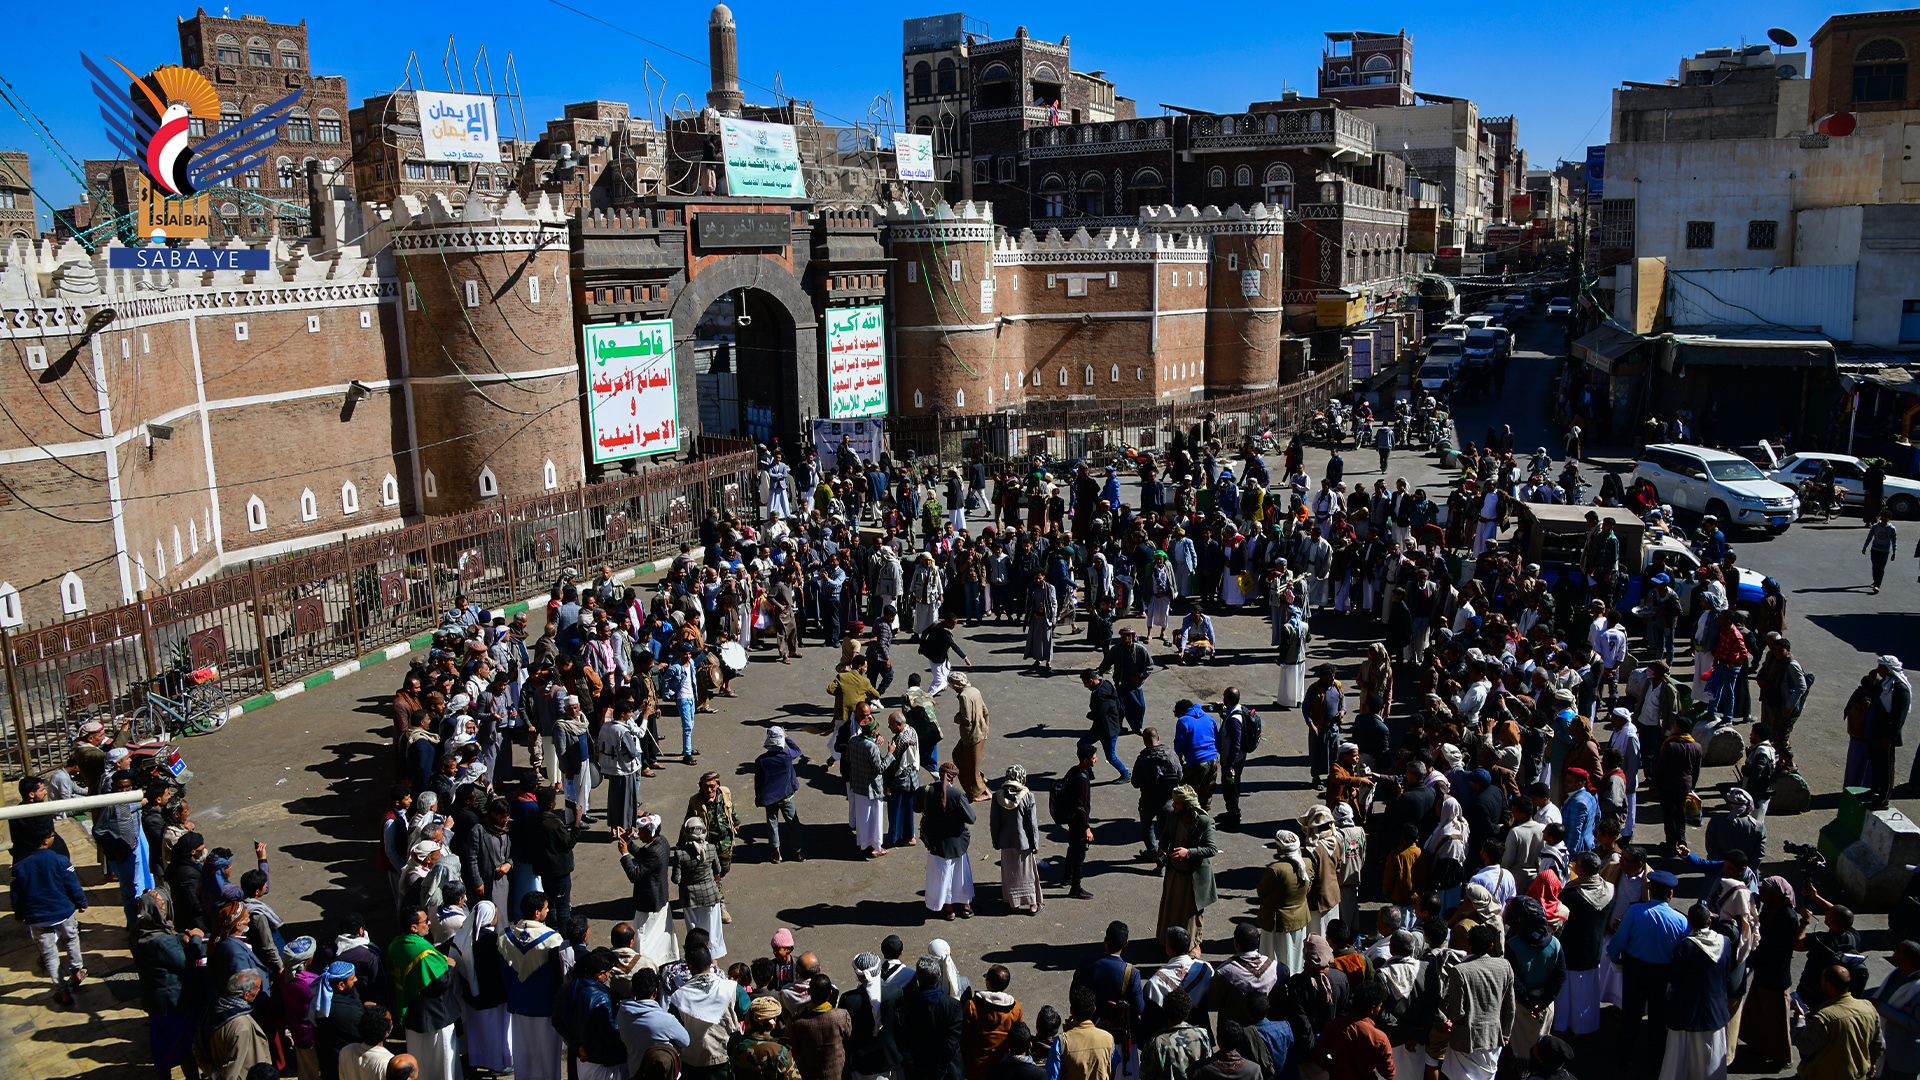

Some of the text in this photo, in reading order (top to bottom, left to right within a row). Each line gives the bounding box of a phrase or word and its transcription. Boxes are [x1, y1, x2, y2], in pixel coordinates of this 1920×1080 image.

[728, 218, 755, 238] الخير
[758, 222, 777, 237] بيده
[830, 310, 881, 338] الله أكبر
[592, 329, 664, 367] قاطعوا
[830, 335, 882, 354] الموت لأمريكا
[861, 354, 883, 370] الموت
[592, 365, 672, 398] البضائع الأمريكية
[832, 372, 884, 394] اللعنة على اليهود
[630, 396, 637, 417] و
[833, 389, 885, 416] النصر للإسلام
[598, 419, 676, 453] الإسرائيلية
